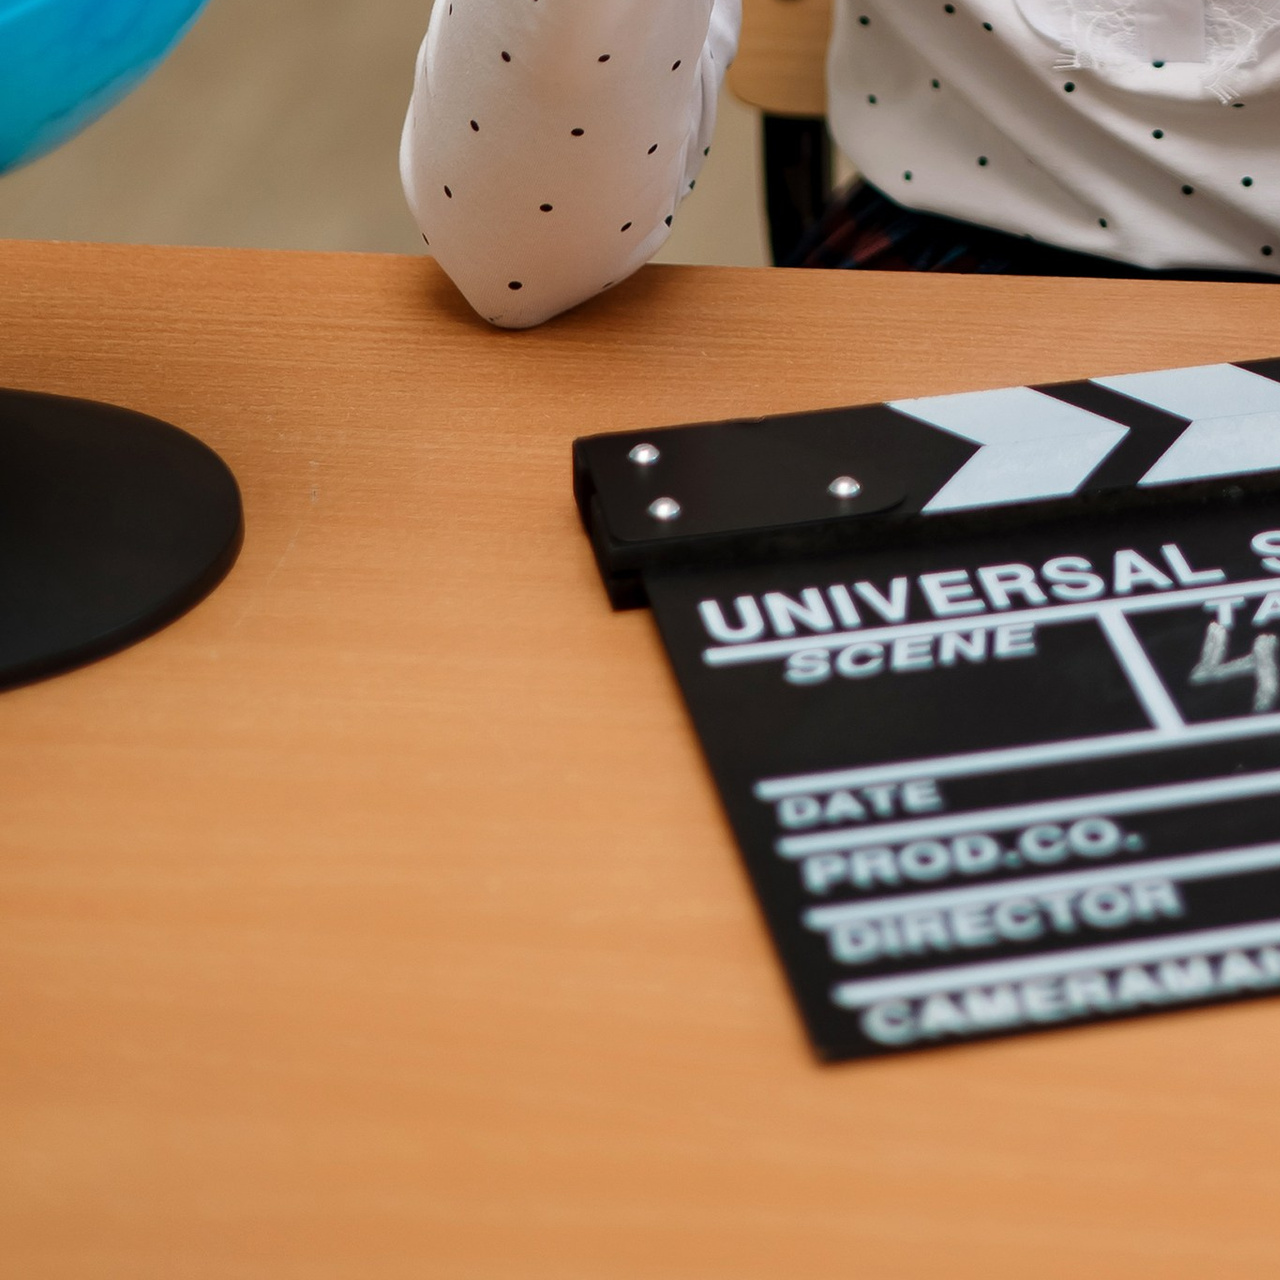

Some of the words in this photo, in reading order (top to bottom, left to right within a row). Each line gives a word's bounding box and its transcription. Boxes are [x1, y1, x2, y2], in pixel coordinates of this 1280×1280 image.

[698, 543, 1227, 643] UNIVERSAL
[784, 622, 1037, 686] SCENE
[776, 780, 944, 830] DATE
[828, 878, 1184, 963] DIRECTOR
